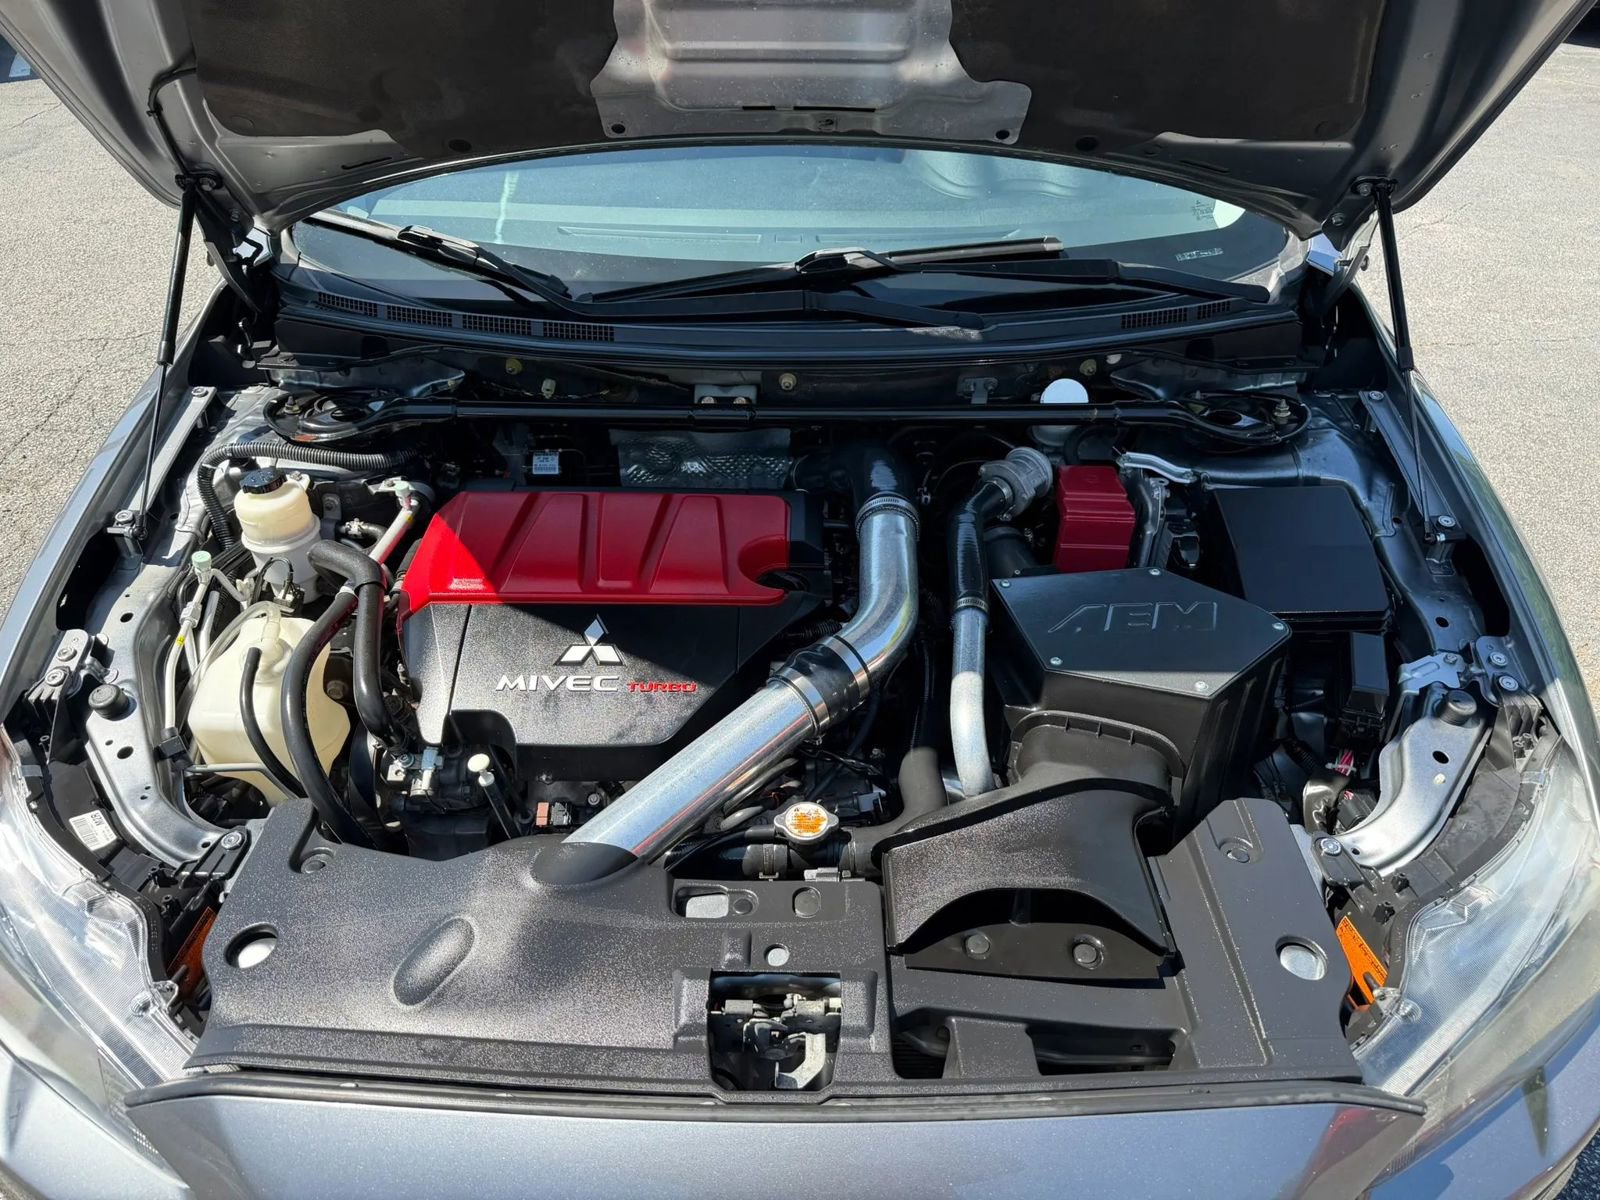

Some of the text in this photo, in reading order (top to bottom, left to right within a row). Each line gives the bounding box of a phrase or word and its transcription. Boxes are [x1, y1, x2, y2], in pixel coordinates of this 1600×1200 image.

[1048, 601, 1218, 633] AEM
[495, 674, 698, 693] MIVEC TURBO
